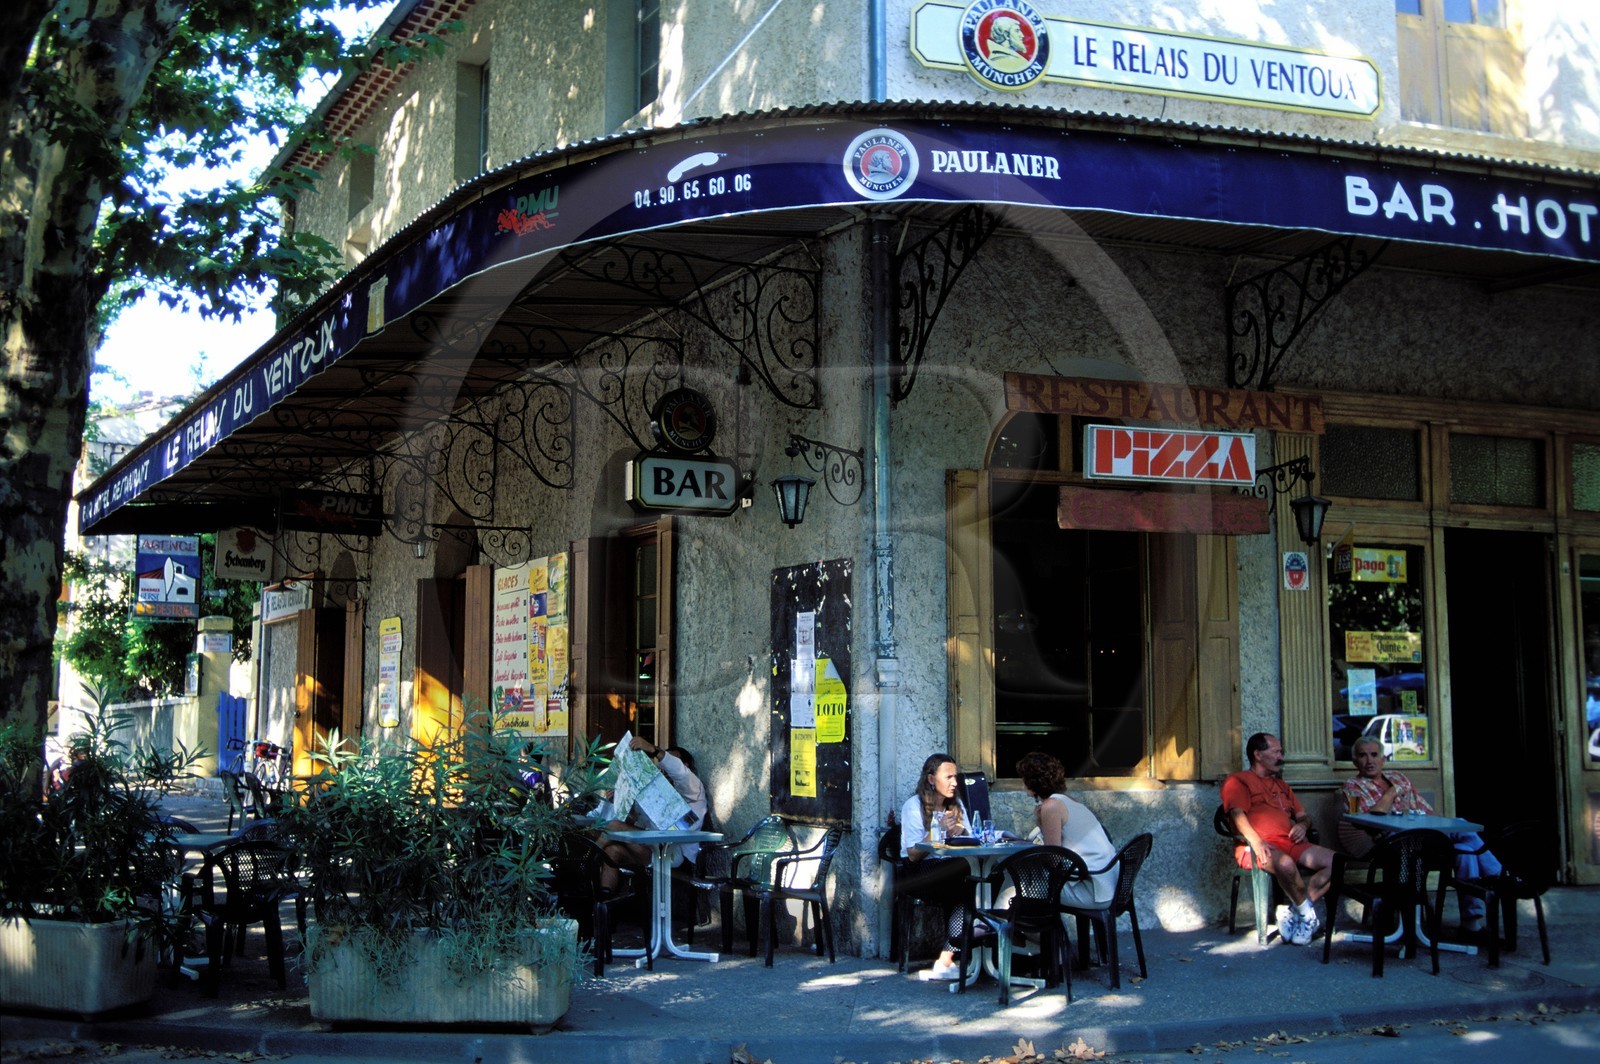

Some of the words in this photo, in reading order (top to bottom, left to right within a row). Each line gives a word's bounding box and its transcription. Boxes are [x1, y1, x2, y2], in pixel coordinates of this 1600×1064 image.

[965, 0, 1046, 37] PAULANER
[1073, 35, 1097, 67] LE
[1113, 40, 1189, 79] RELAIS
[1204, 52, 1237, 85] DU
[1250, 59, 1357, 100] VENTOUX
[854, 137, 907, 159] PAULANER
[931, 150, 1061, 179] PAULANER
[516, 185, 559, 218] PMU
[1345, 175, 1456, 226] BAR
[166, 436, 181, 469] LE
[187, 398, 227, 456] RELAIS
[233, 379, 253, 421] DU
[263, 314, 335, 398] VENTOUX
[1013, 375, 1324, 432] RESTAURANT
[653, 466, 727, 500] BAR
[321, 494, 373, 515] PMU
[497, 575, 519, 592] GLACES
[817, 702, 844, 717] LOTO
